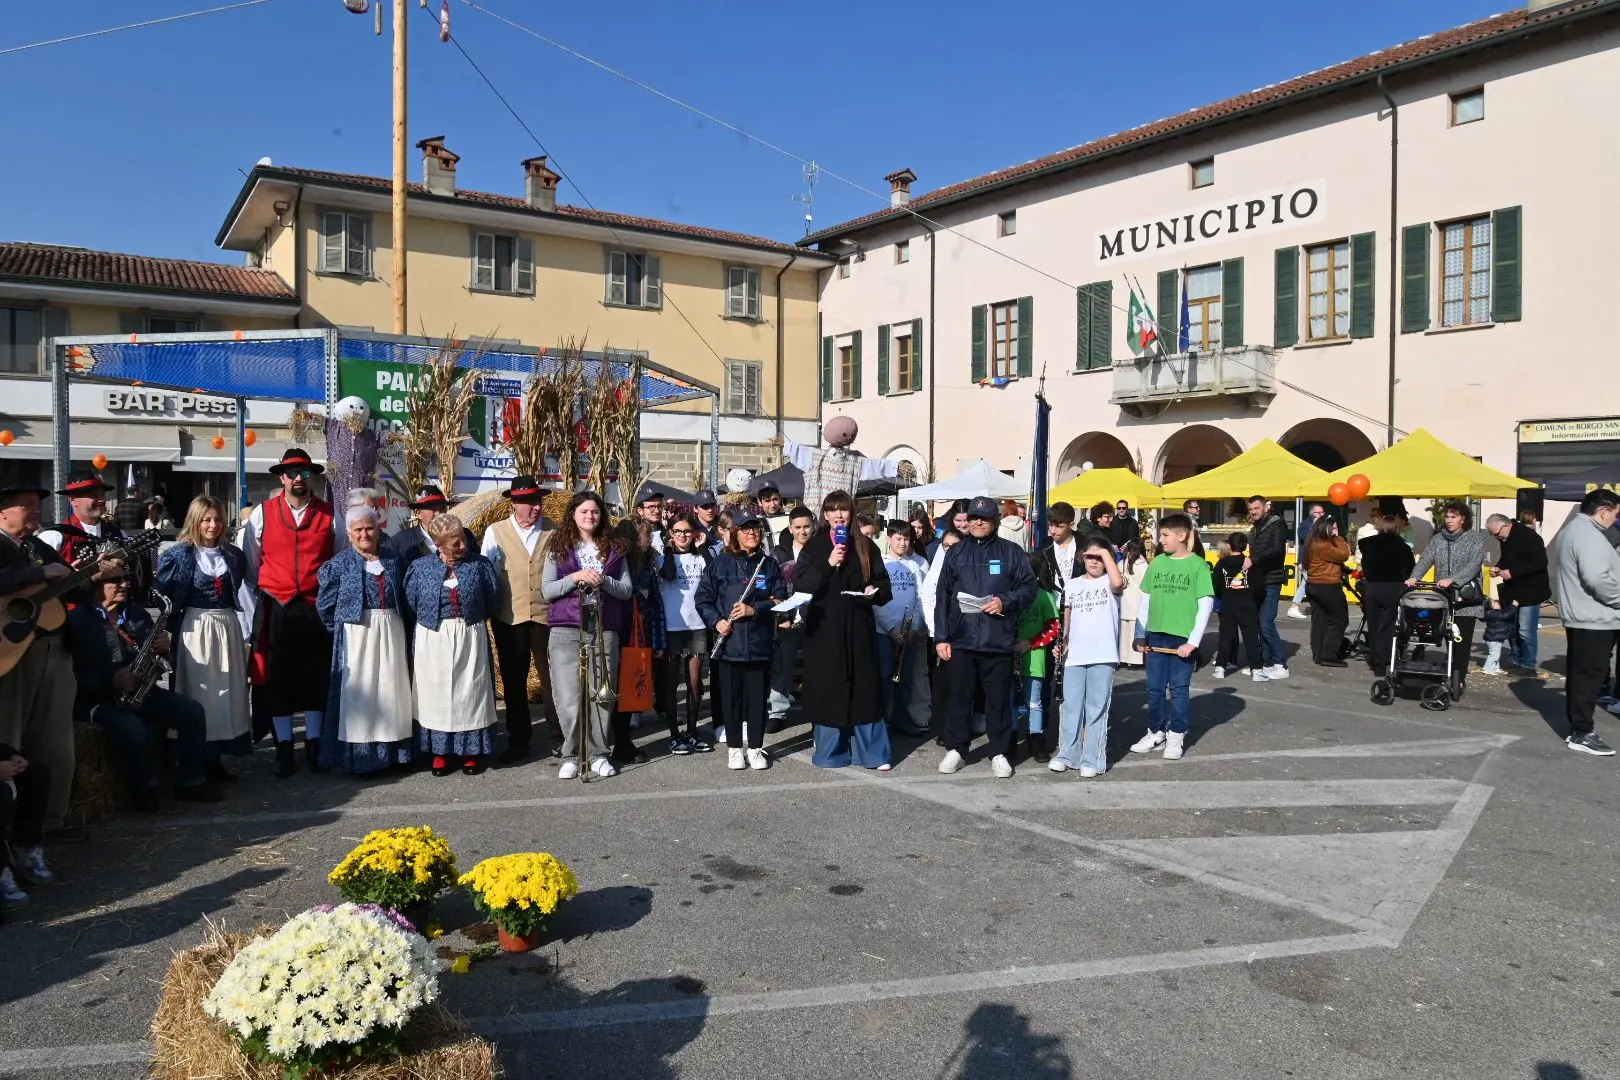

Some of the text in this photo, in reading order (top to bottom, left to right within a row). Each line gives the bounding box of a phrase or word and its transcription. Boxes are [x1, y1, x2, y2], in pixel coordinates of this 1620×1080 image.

[1099, 187, 1318, 260] MUNICIPIO
[105, 389, 165, 412] BAR
[1536, 424, 1568, 432] COMUNE
[1576, 422, 1603, 430] BORGO
[1605, 421, 1619, 429] SAN
[1551, 431, 1599, 439] Informazioni
